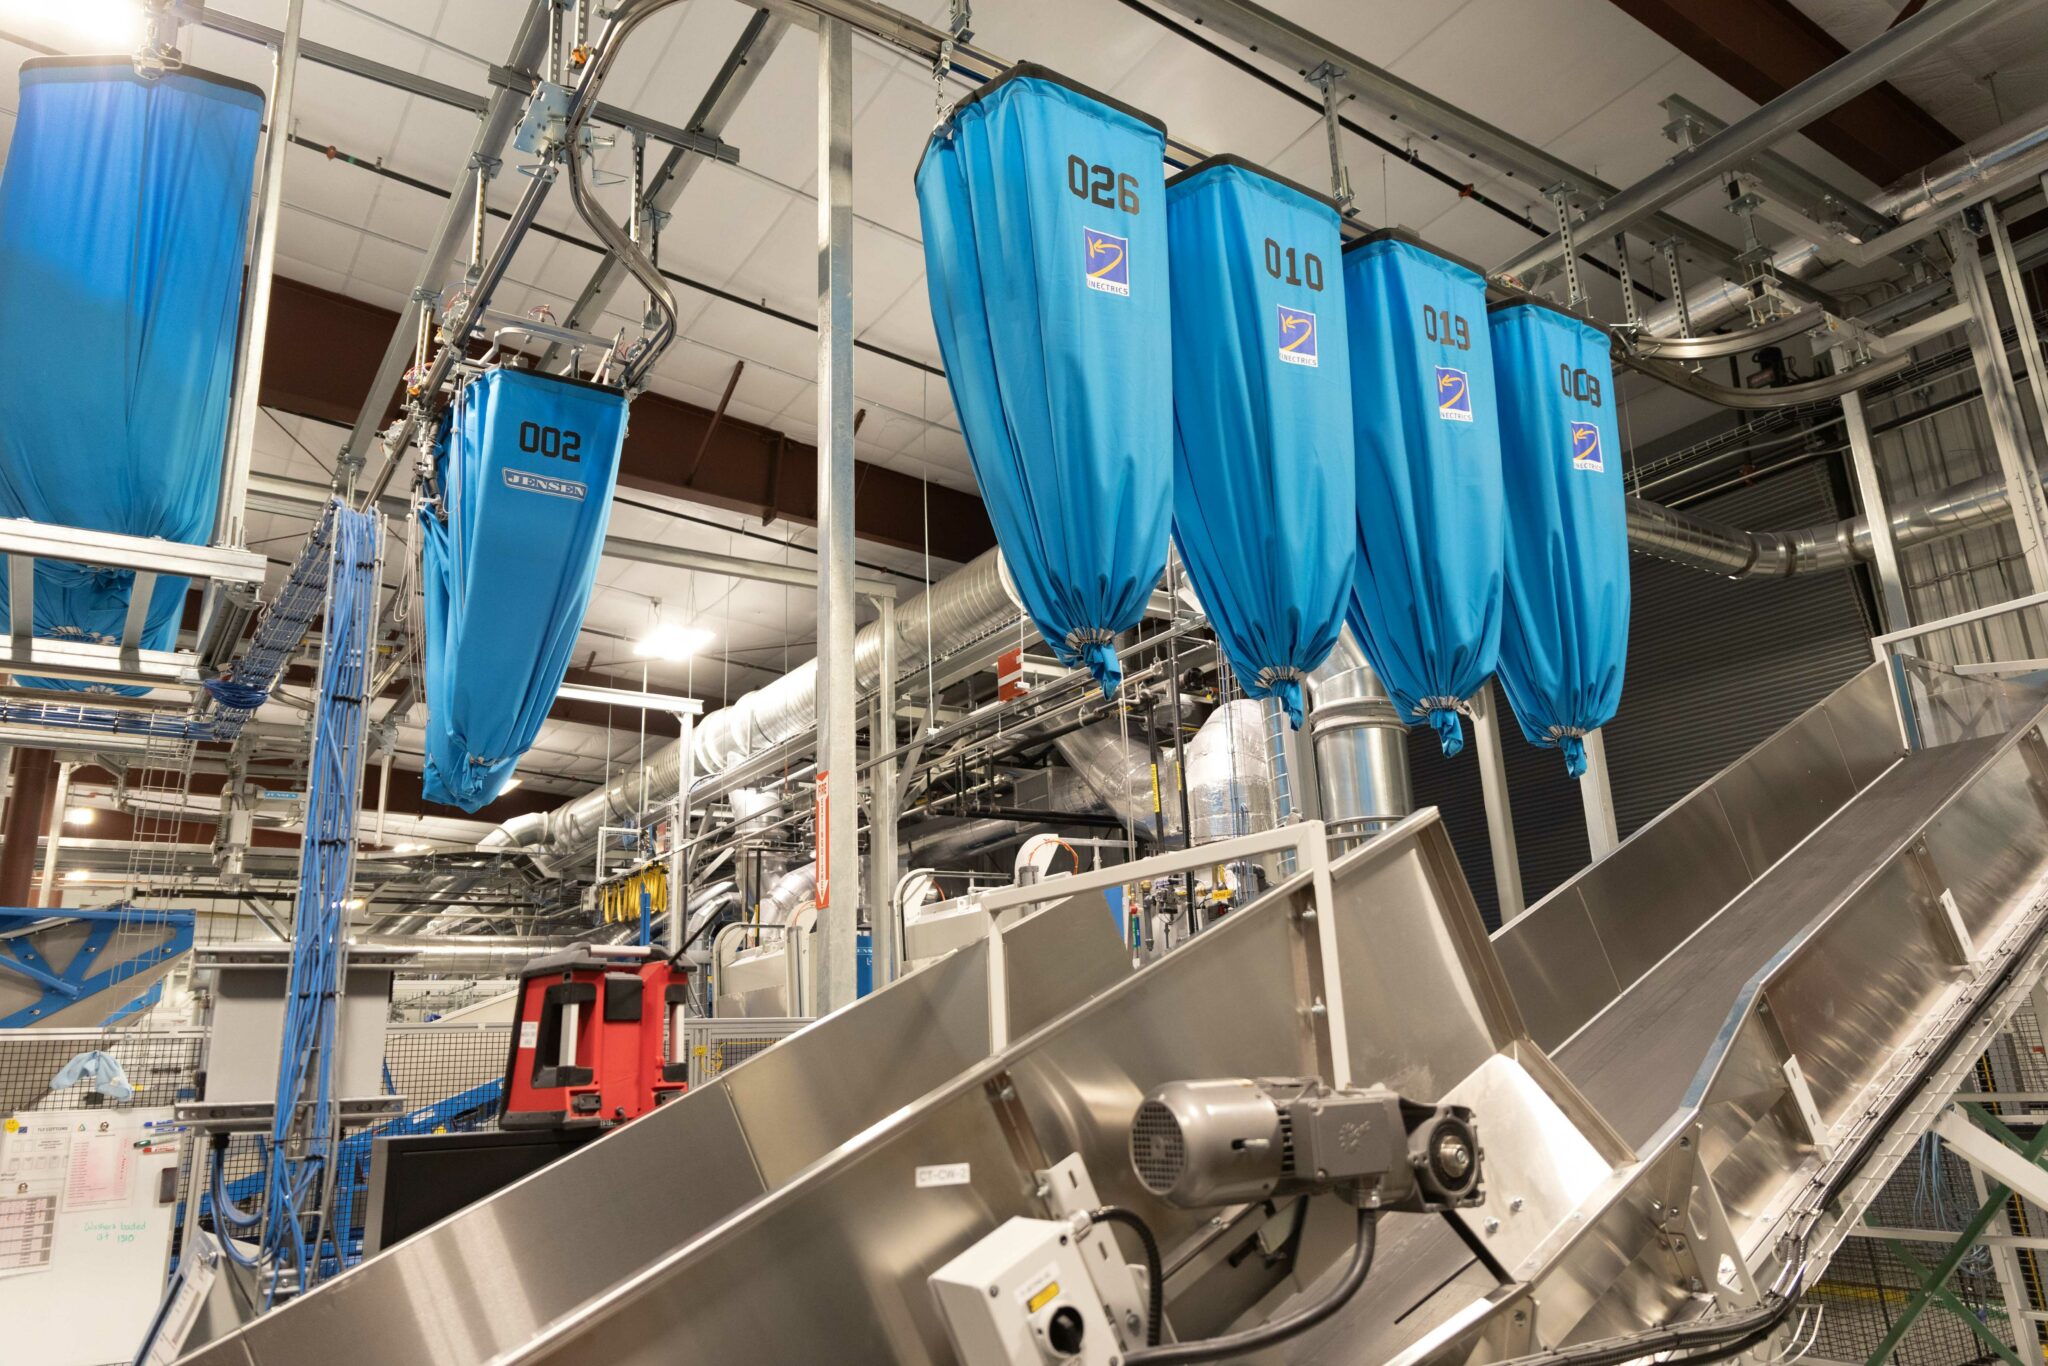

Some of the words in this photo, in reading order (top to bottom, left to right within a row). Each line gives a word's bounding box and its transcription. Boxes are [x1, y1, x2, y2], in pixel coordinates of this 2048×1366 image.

[1067, 154, 1140, 216] 026
[1264, 237, 1324, 292] 010
[1423, 304, 1471, 351] 019
[520, 421, 581, 463] 002
[508, 475, 584, 496] JENSEN
